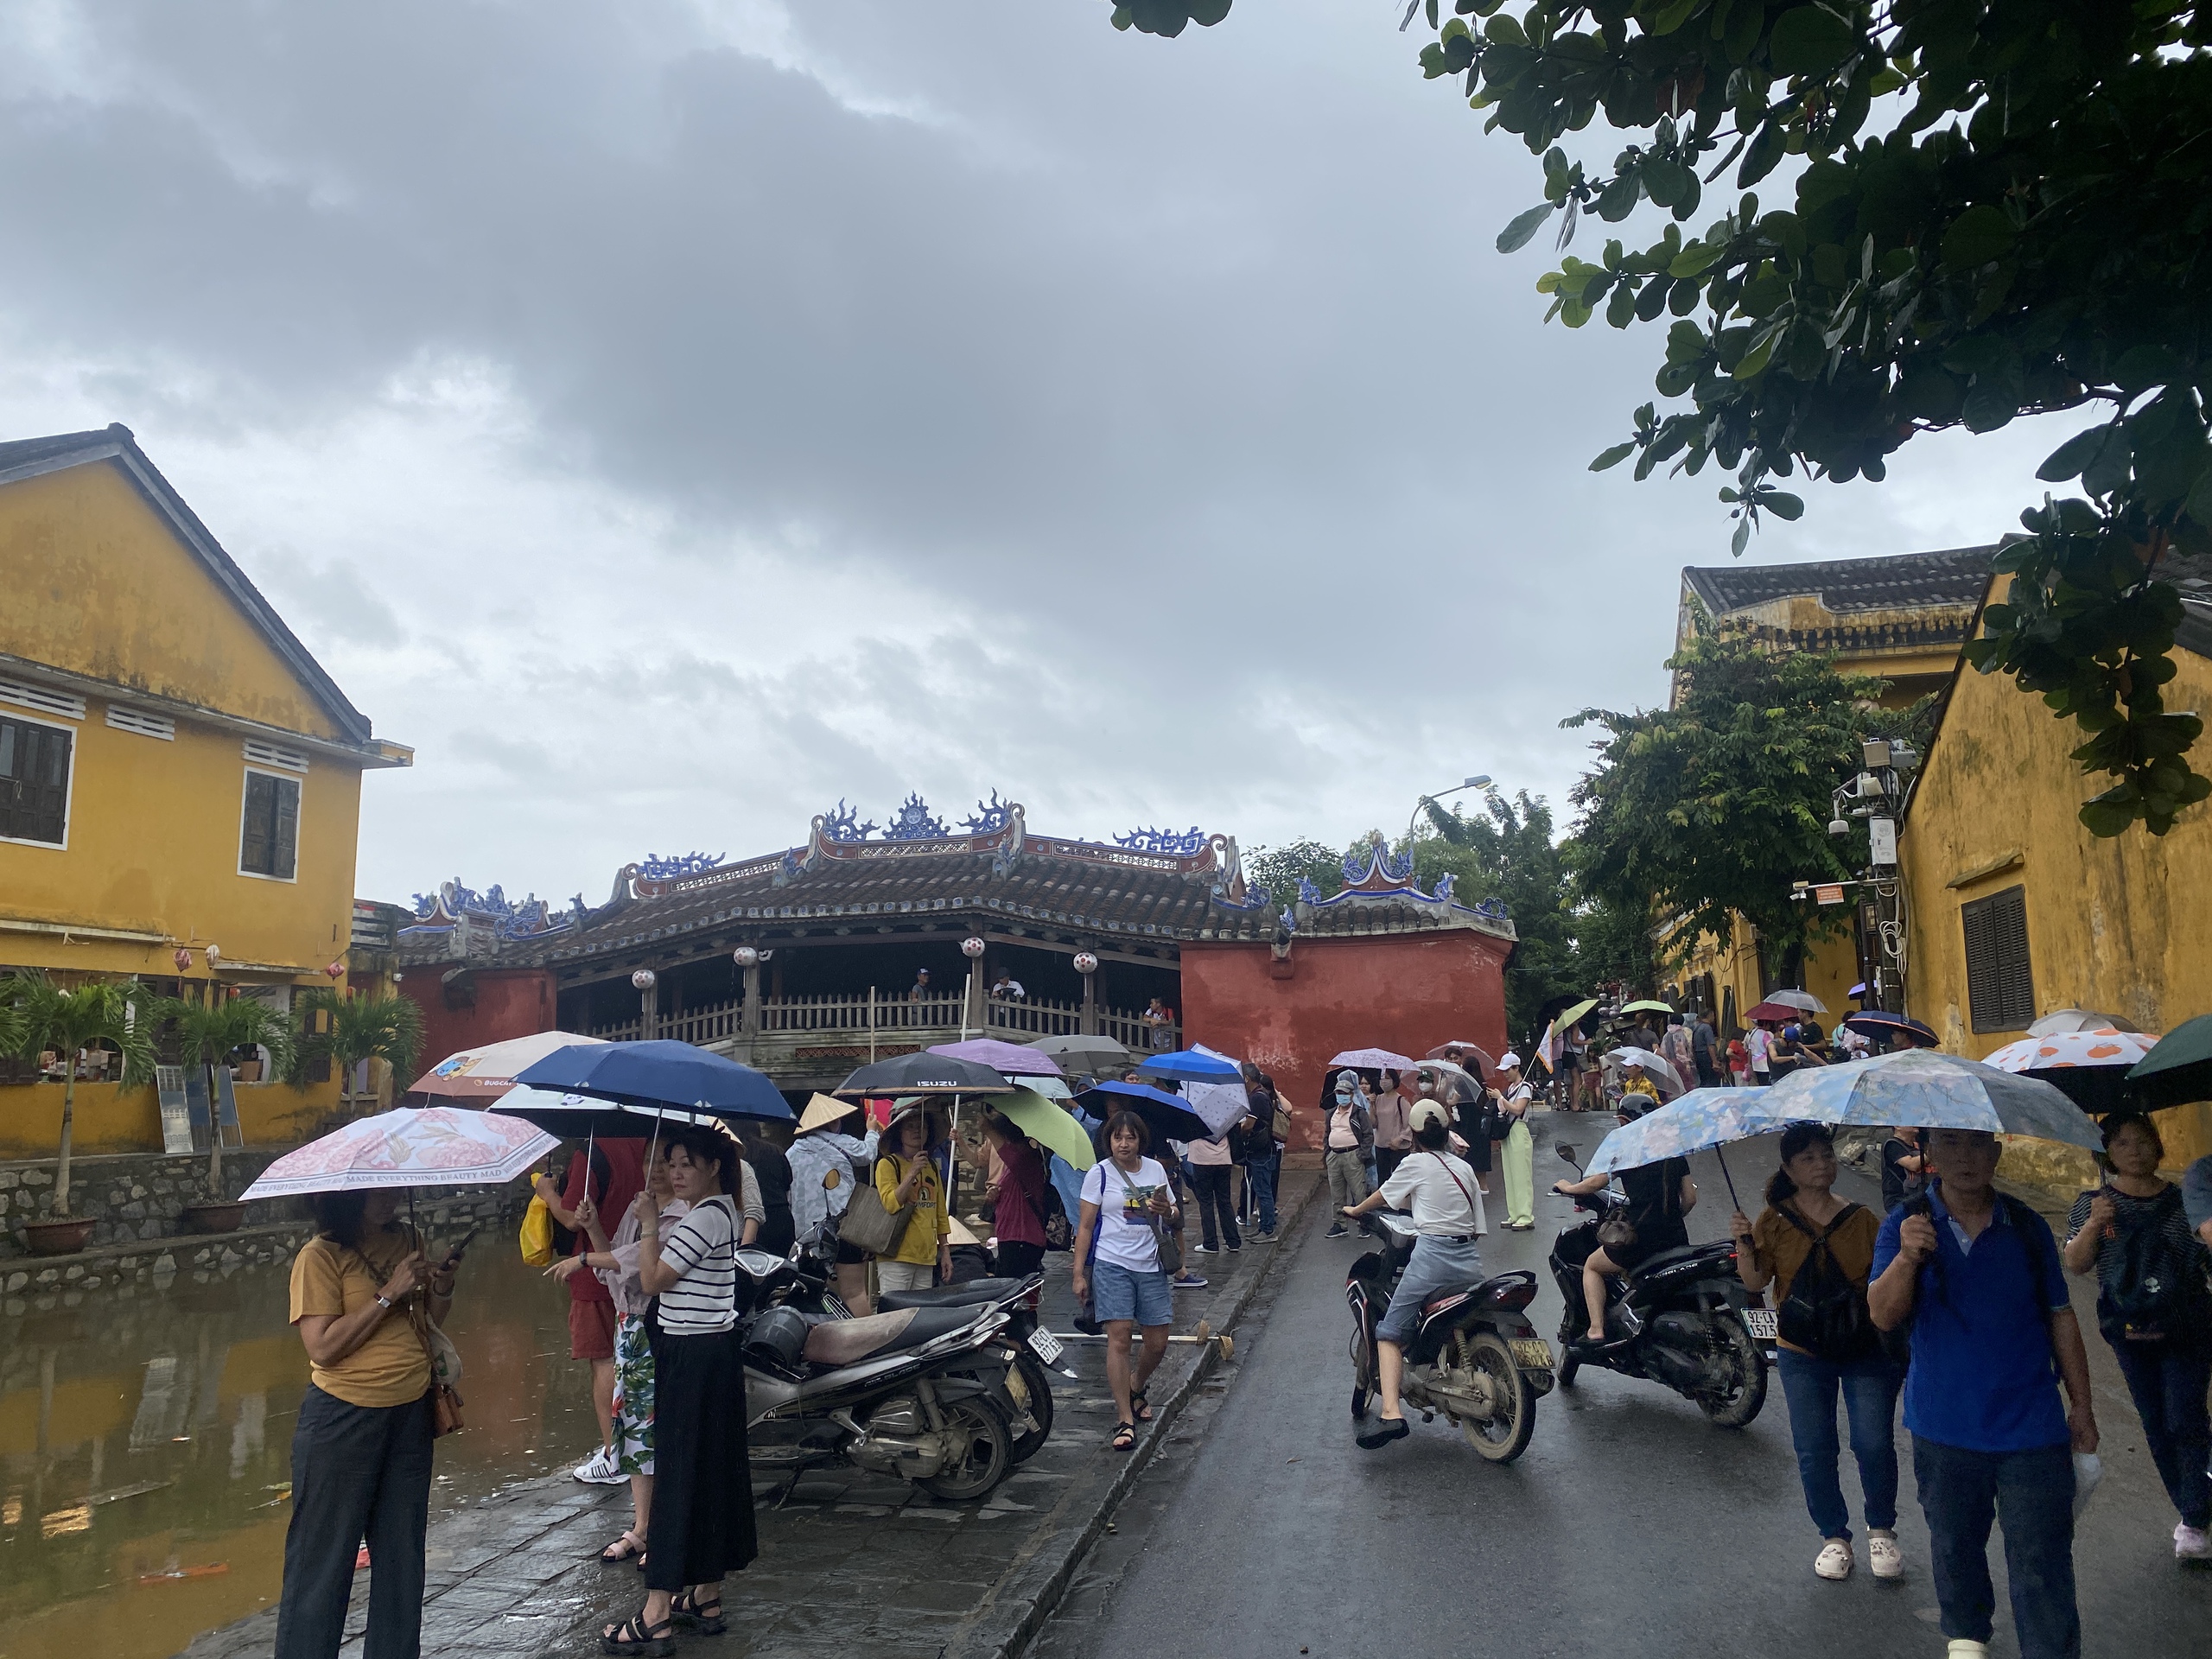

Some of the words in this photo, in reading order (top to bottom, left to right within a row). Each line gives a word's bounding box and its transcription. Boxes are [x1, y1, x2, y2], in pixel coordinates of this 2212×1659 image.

[346, 1174, 375, 1183] MADE
[440, 1172, 478, 1181] BEAUTY
[480, 1169, 502, 1178] MAD
[1747, 1311, 1776, 1324] 92-CA
[1750, 1324, 1777, 1337] 157.5
[1032, 1330, 1050, 1349] 92-C1
